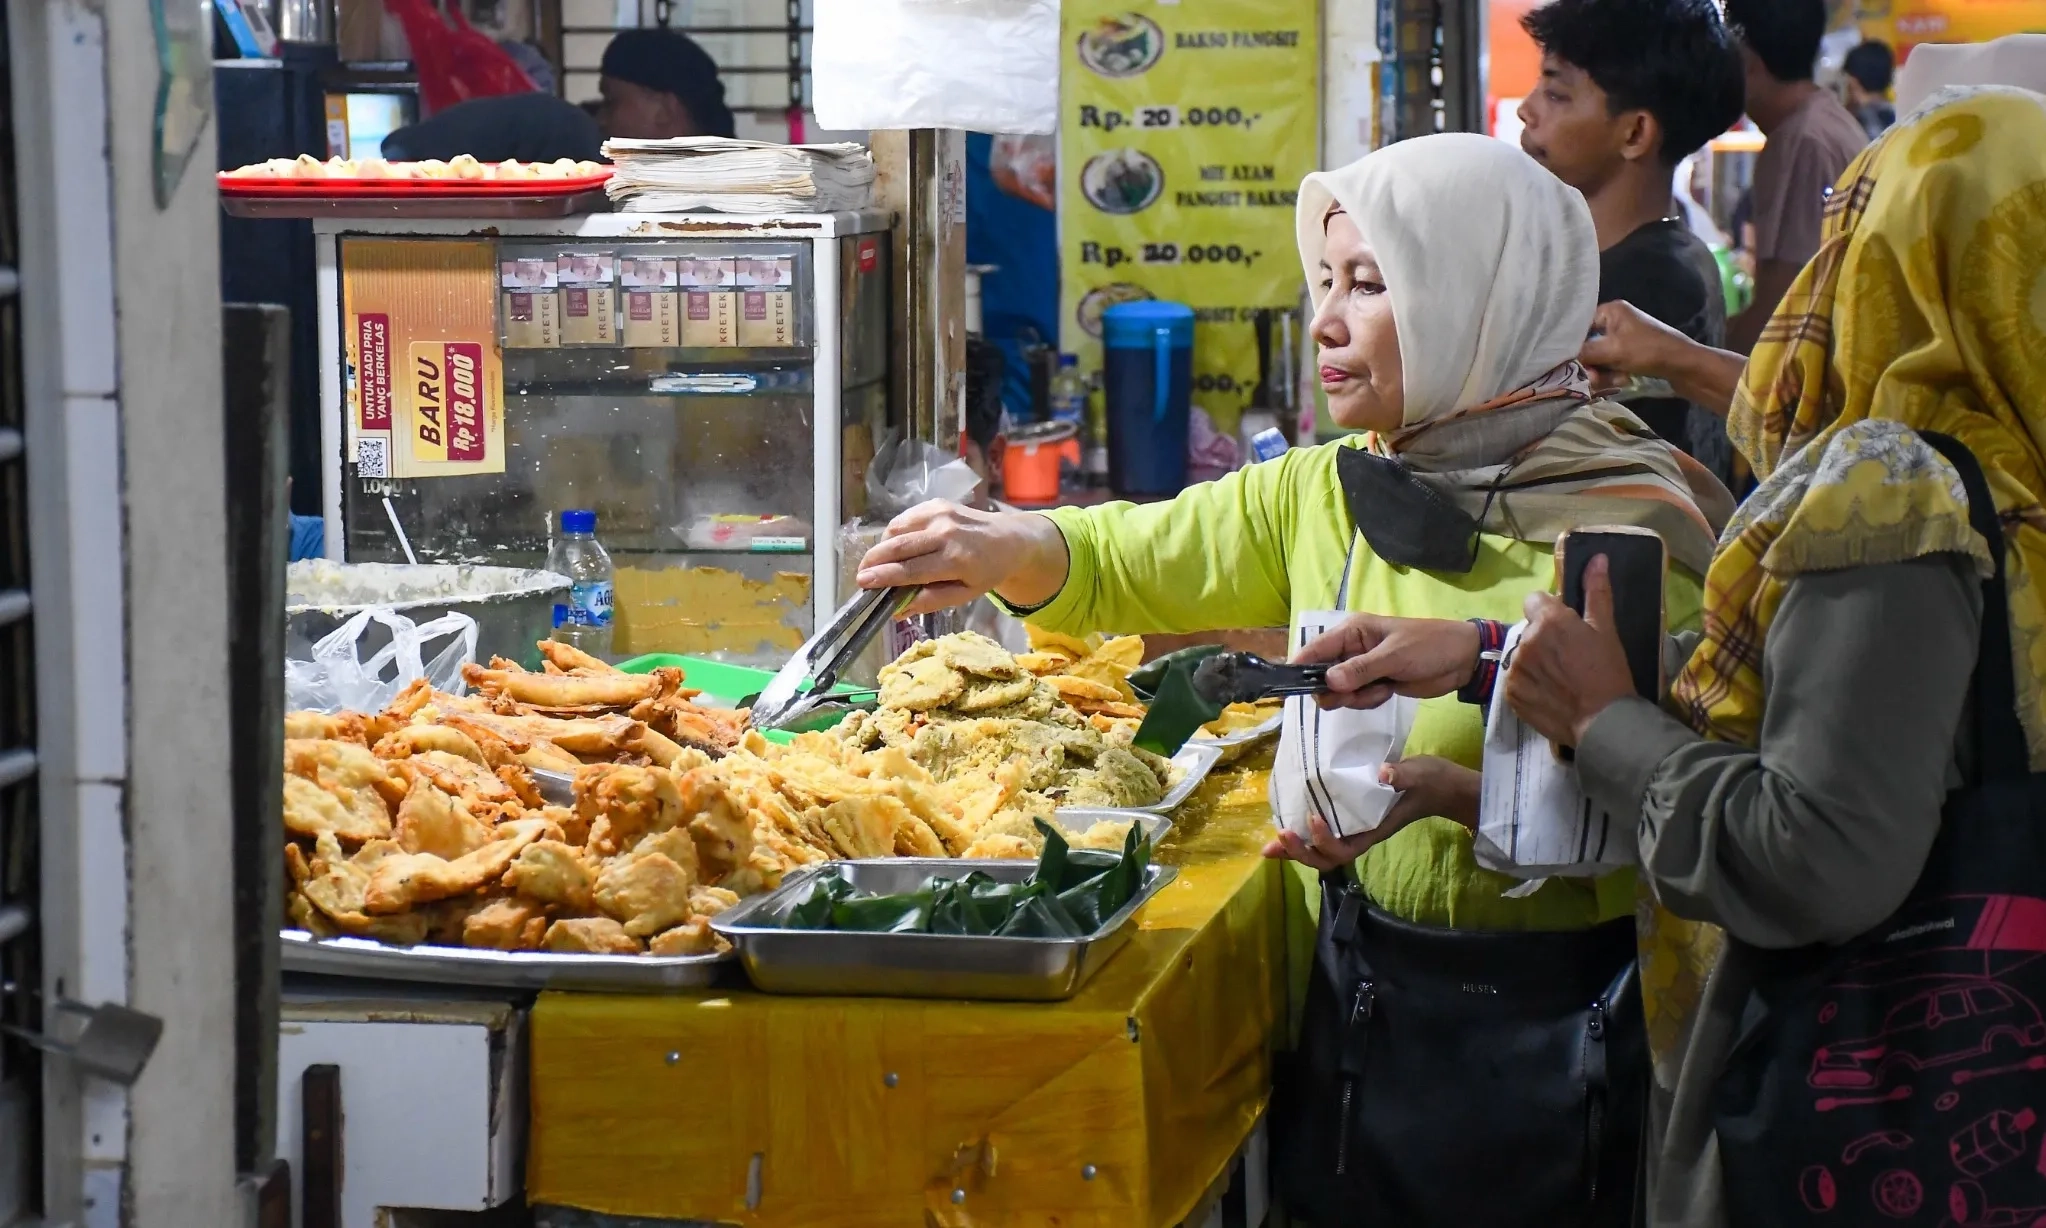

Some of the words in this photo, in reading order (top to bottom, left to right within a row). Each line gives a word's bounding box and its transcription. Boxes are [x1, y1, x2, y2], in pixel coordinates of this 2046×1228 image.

[1175, 31, 1228, 49] BAKSO
[1080, 105, 1131, 132] Rp.
[1081, 242, 1133, 268] Rp.
[363, 320, 373, 347] PRIA
[542, 295, 551, 344] KRETEK
[597, 291, 607, 339] KRETEK
[660, 294, 670, 343] KRETEK
[718, 294, 728, 343] KRETEK
[775, 294, 785, 342] KRETEK
[363, 349, 374, 378] JADI
[374, 323, 386, 387] BERKELAS
[363, 381, 375, 420] UNTUK
[376, 389, 387, 420] YANG
[417, 356, 441, 447] BARU
